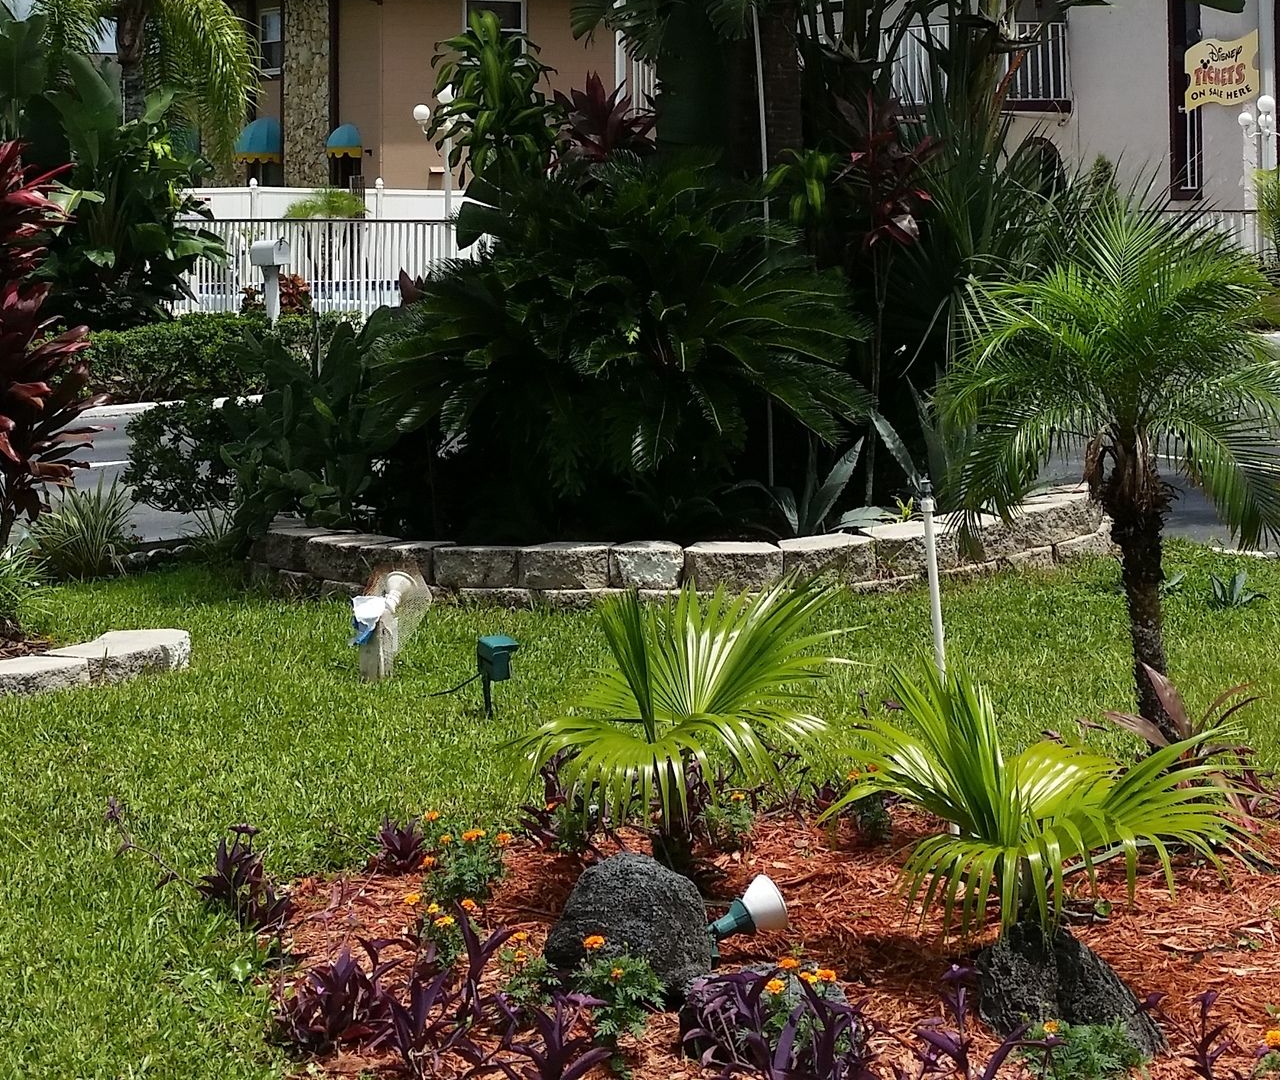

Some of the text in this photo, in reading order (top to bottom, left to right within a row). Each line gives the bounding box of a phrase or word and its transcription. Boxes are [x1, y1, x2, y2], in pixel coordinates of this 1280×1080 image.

[1191, 84, 1252, 100] ON SALE HERE
